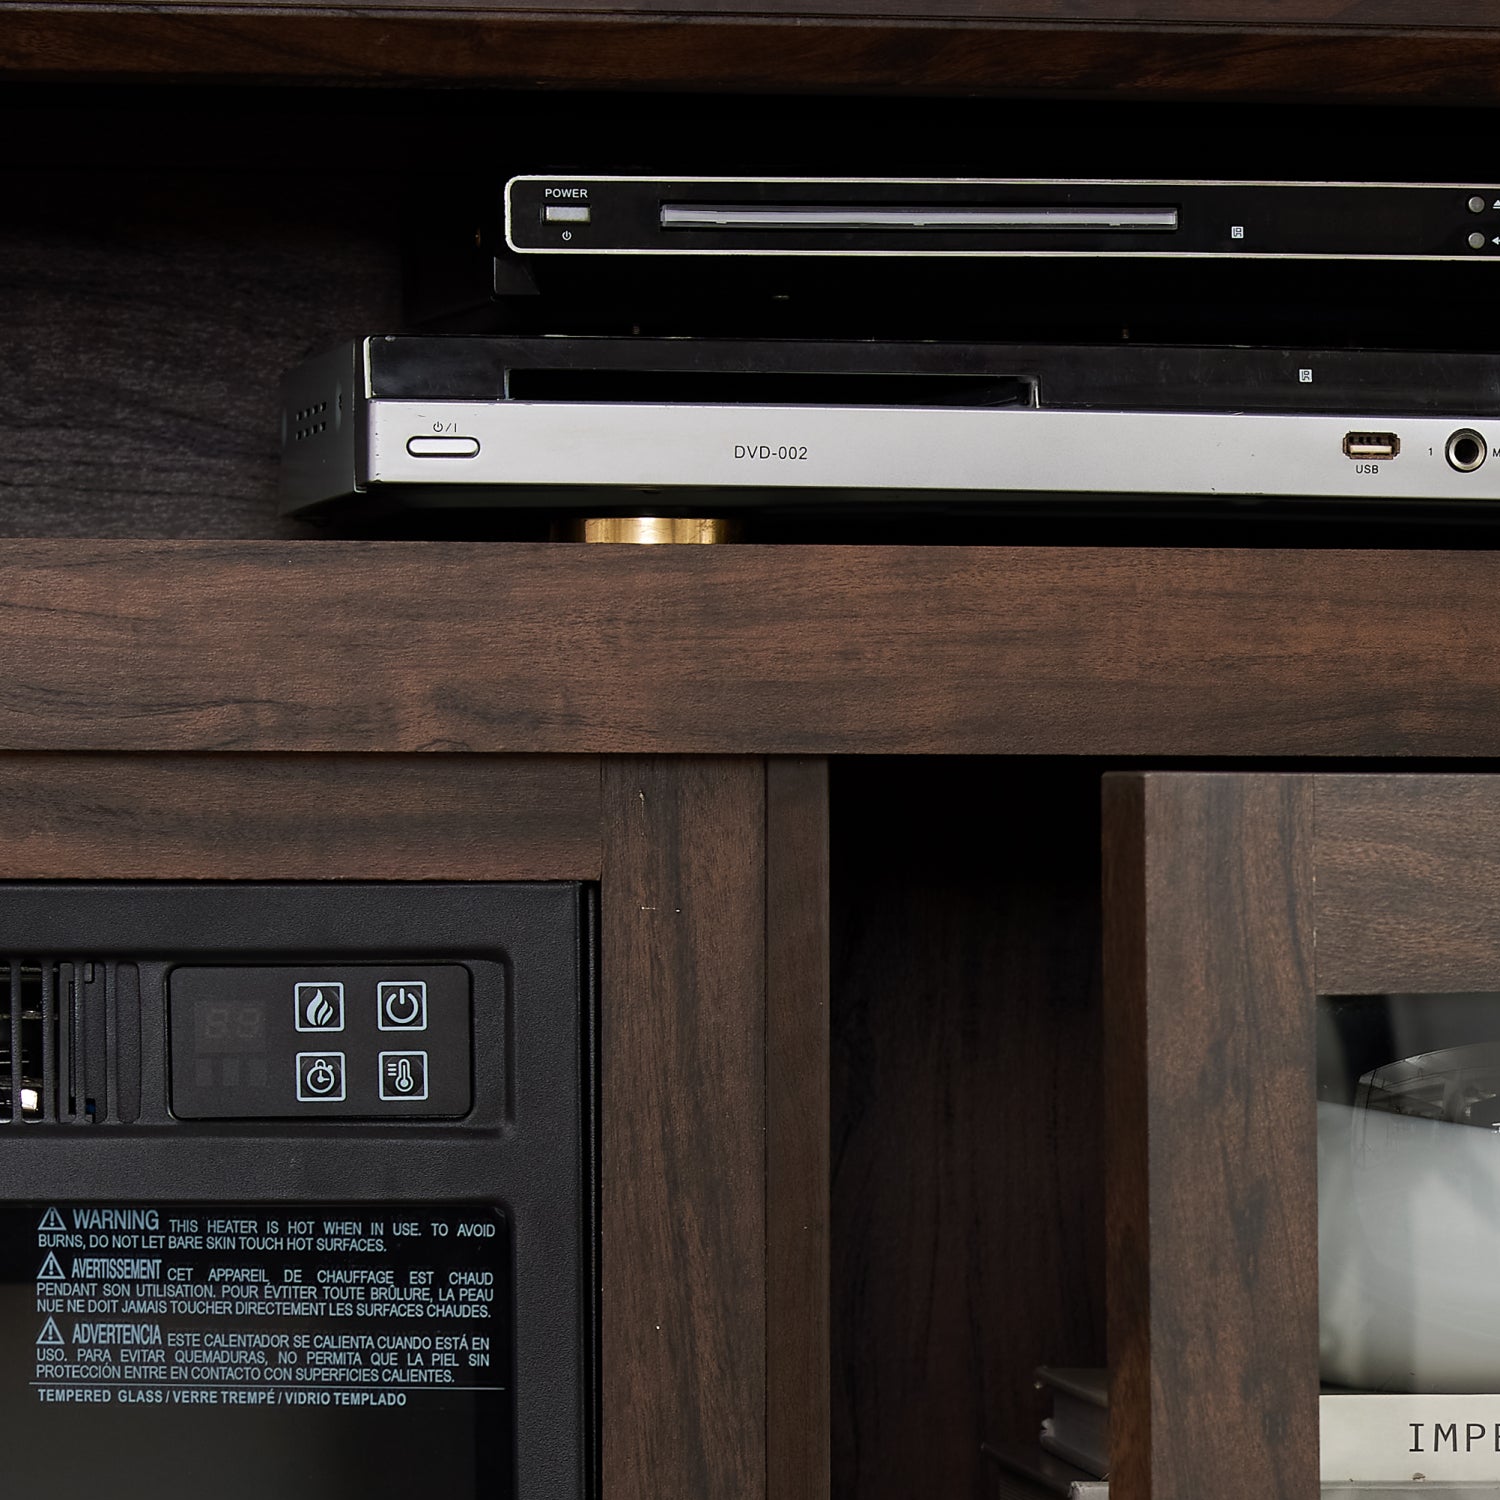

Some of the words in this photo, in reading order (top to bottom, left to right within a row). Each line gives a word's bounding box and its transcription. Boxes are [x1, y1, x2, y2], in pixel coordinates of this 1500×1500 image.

[545, 188, 588, 198] POWER
[734, 445, 808, 460] DVD-002
[1428, 447, 1433, 456] 1
[1355, 464, 1379, 475] USB
[73, 1209, 159, 1230] WARNING
[169, 1220, 198, 1233] THIS
[207, 1220, 257, 1234] HEATER
[267, 1221, 279, 1234] IS
[288, 1221, 315, 1235] HOT
[324, 1221, 362, 1235] WHEN
[371, 1222, 384, 1236] IN
[393, 1222, 421, 1236] USE.
[431, 1223, 448, 1236] TO
[457, 1223, 495, 1237] AVOID
[38, 1234, 86, 1250] BURNS,
[90, 1235, 108, 1248] DO
[112, 1235, 139, 1248] NOT
[142, 1236, 164, 1249] LET
[168, 1236, 203, 1249] BARE
[206, 1237, 236, 1249] SKIN
[239, 1237, 283, 1250] TOUCH
[287, 1238, 313, 1250] HOT
[316, 1238, 387, 1251] SURFACES.
[71, 1257, 162, 1280] AVERTISSEMENT
[167, 1267, 193, 1281] CET
[208, 1268, 269, 1282] APPAREIL
[284, 1269, 302, 1283] DE
[317, 1269, 394, 1284] CHAUFFAGE
[410, 1271, 434, 1284] EST
[449, 1271, 493, 1285] CHAUD
[36, 1282, 97, 1297] PENDANT
[102, 1283, 131, 1297] SON
[136, 1284, 216, 1298] UTILISATION.
[222, 1285, 258, 1299] POUR
[323, 1286, 364, 1300] TOUTE
[370, 1283, 433, 1303] BRÛLURE,
[439, 1287, 455, 1301] LA
[459, 1287, 494, 1301] PEAU
[36, 1299, 64, 1313] NUE
[67, 1300, 85, 1313] NE
[88, 1300, 118, 1313] DOIT
[121, 1300, 167, 1314] JAMAIS
[170, 1301, 232, 1315] TOUCHER
[236, 1302, 326, 1316] DIRECTEMENT
[329, 1303, 353, 1316] LES
[356, 1303, 423, 1317] SURFACES
[427, 1304, 491, 1318] CHAUDES.
[72, 1323, 162, 1345] ADVERTENCIA
[167, 1333, 200, 1347] ESTE
[204, 1334, 289, 1348] CALENTADOR
[293, 1335, 310, 1348] SE
[313, 1335, 374, 1349] CALIENTA
[377, 1336, 431, 1350] CUANDO
[435, 1334, 468, 1350] ESTÁ
[472, 1337, 490, 1350] EN
[36, 1348, 67, 1362] USO.
[77, 1349, 112, 1362] PARA
[120, 1349, 165, 1363] EVITAR
[175, 1350, 269, 1366] QUEMADURAS,
[278, 1351, 297, 1364] NO
[307, 1351, 362, 1365] PERMITA
[371, 1352, 398, 1365] QUE
[408, 1353, 423, 1366] LA
[432, 1353, 459, 1366] PIEL
[469, 1353, 490, 1366] SIN
[36, 1362, 121, 1379] PROTECCIÓN
[124, 1366, 167, 1379] ENTRE
[170, 1367, 188, 1380] EN
[191, 1367, 260, 1380] CONTACTO
[264, 1368, 292, 1381] CON
[296, 1368, 379, 1382] SUPERFICIES
[382, 1369, 454, 1382] CALIENTES.
[38, 1388, 111, 1402] TEMPERED
[118, 1389, 163, 1403] GLASS
[173, 1390, 218, 1404] VERRE
[221, 1388, 275, 1404] TREMPÉ
[284, 1391, 330, 1405] VIDRIO
[333, 1392, 407, 1406] TEMPLADO
